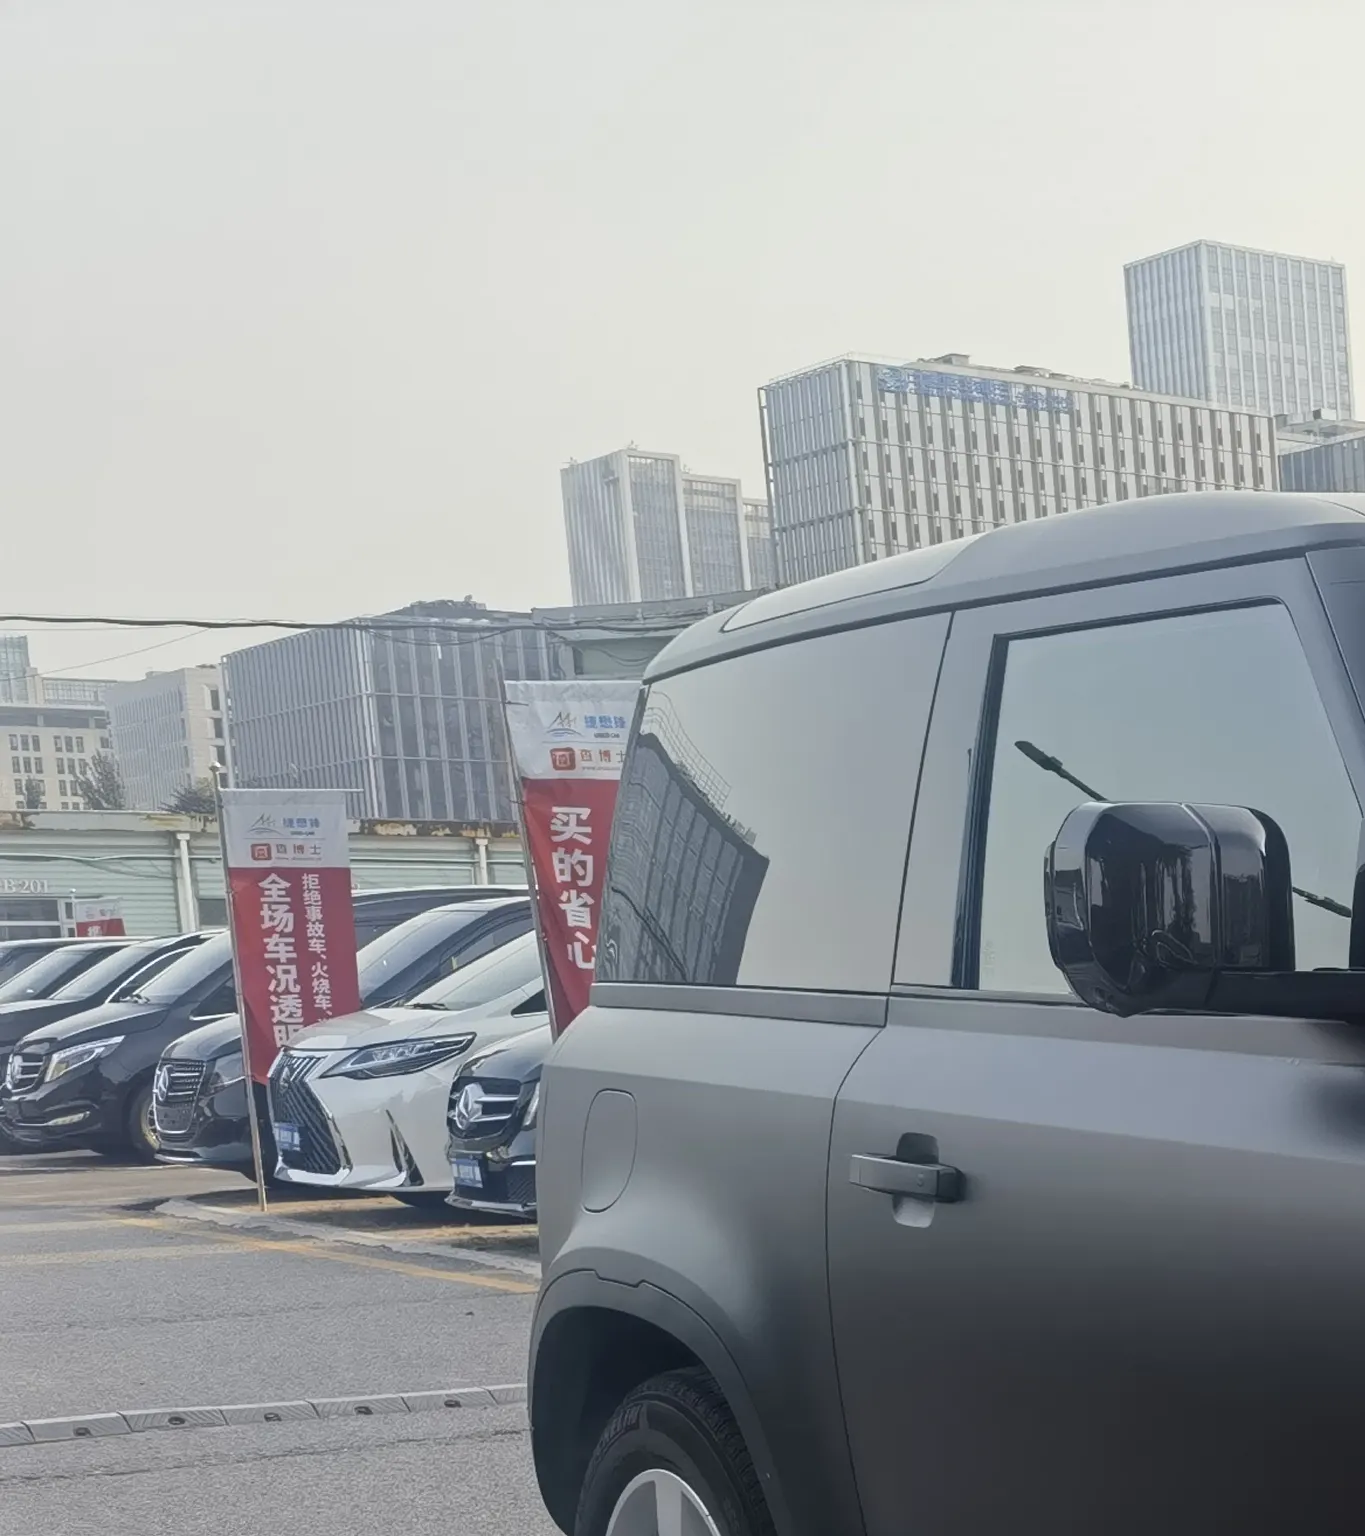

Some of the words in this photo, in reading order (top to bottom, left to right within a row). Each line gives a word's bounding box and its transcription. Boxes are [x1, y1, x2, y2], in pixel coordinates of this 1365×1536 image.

[302, 873, 333, 1024] 拒绝事故车、火烧车、
[550, 805, 596, 970] 买的省心
